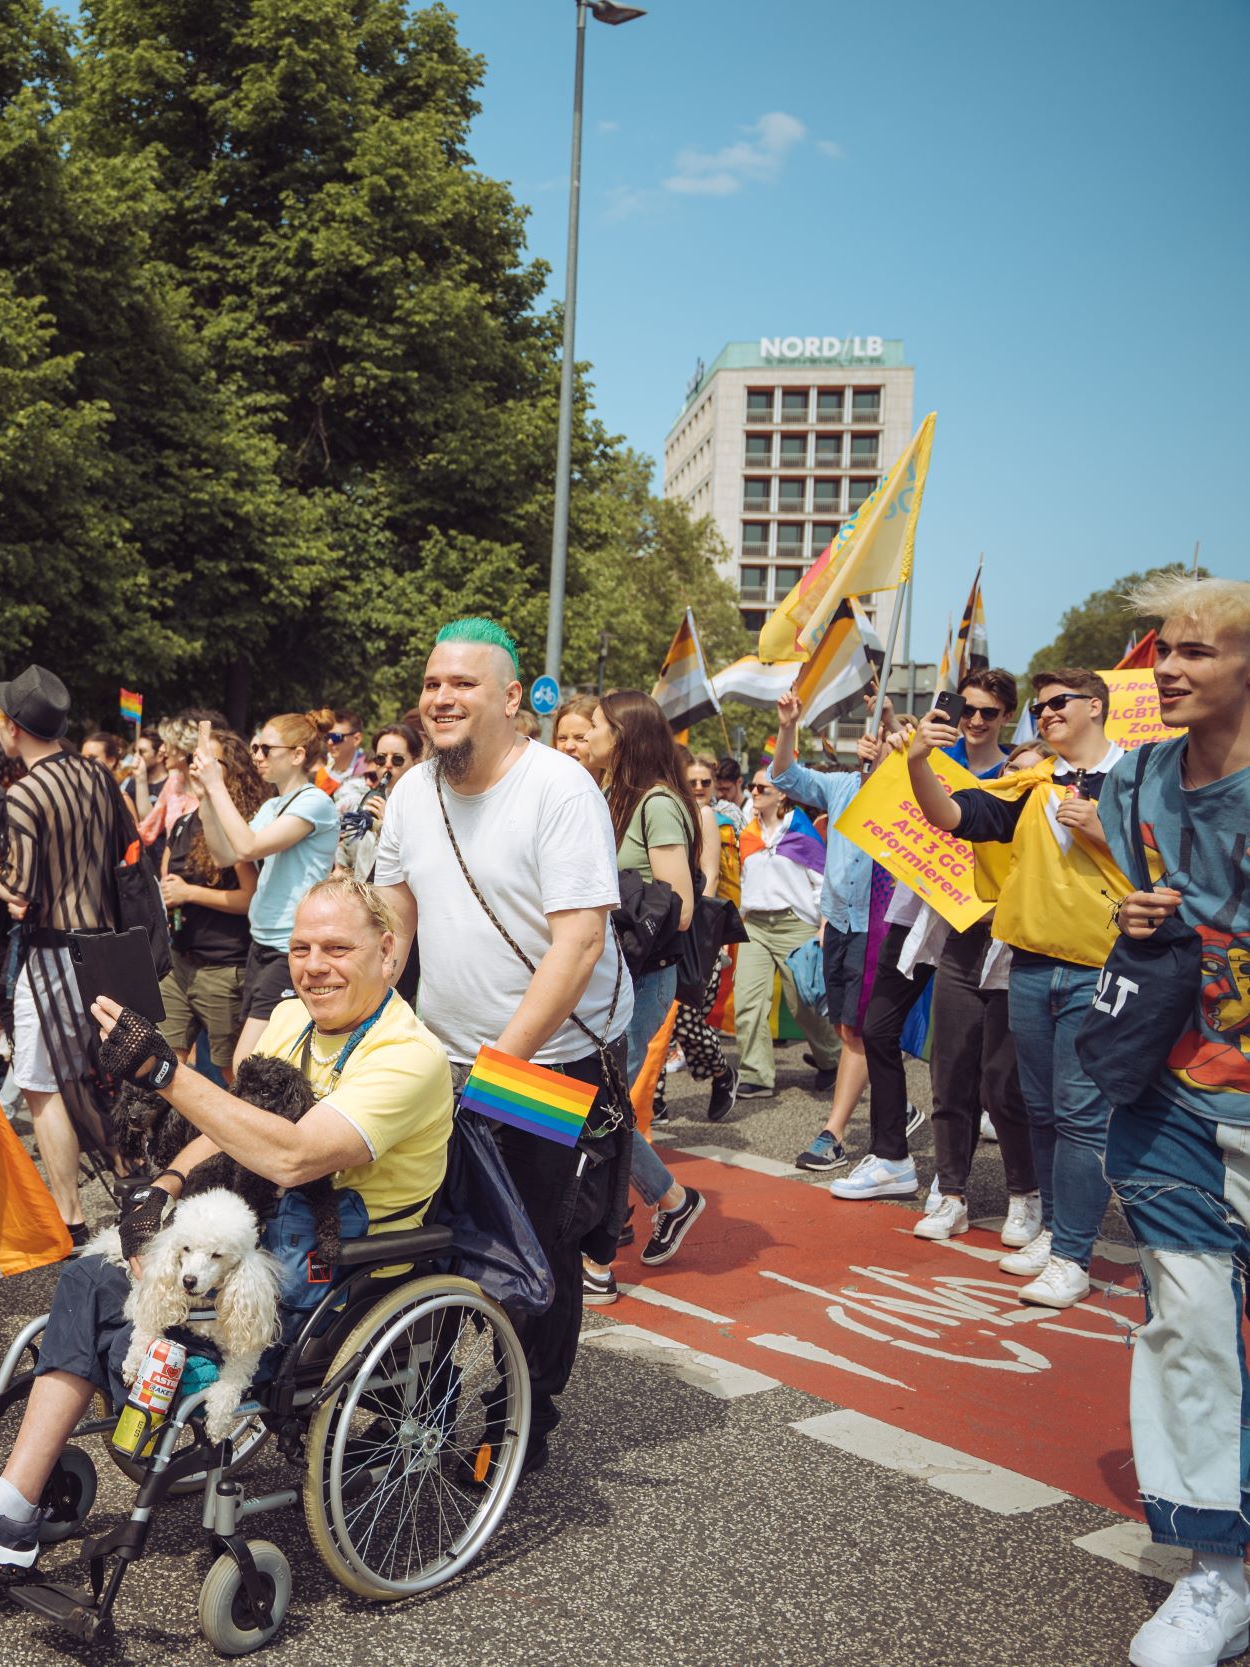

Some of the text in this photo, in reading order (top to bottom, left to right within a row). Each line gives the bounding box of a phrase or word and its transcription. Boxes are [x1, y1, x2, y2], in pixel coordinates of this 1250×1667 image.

[760, 334, 884, 358] NORD/LB
[1135, 694, 1161, 707] ge
[862, 818, 972, 906] reformieren!
[891, 818, 924, 845] Art
[922, 840, 940, 855] 3
[938, 853, 967, 877] GG
